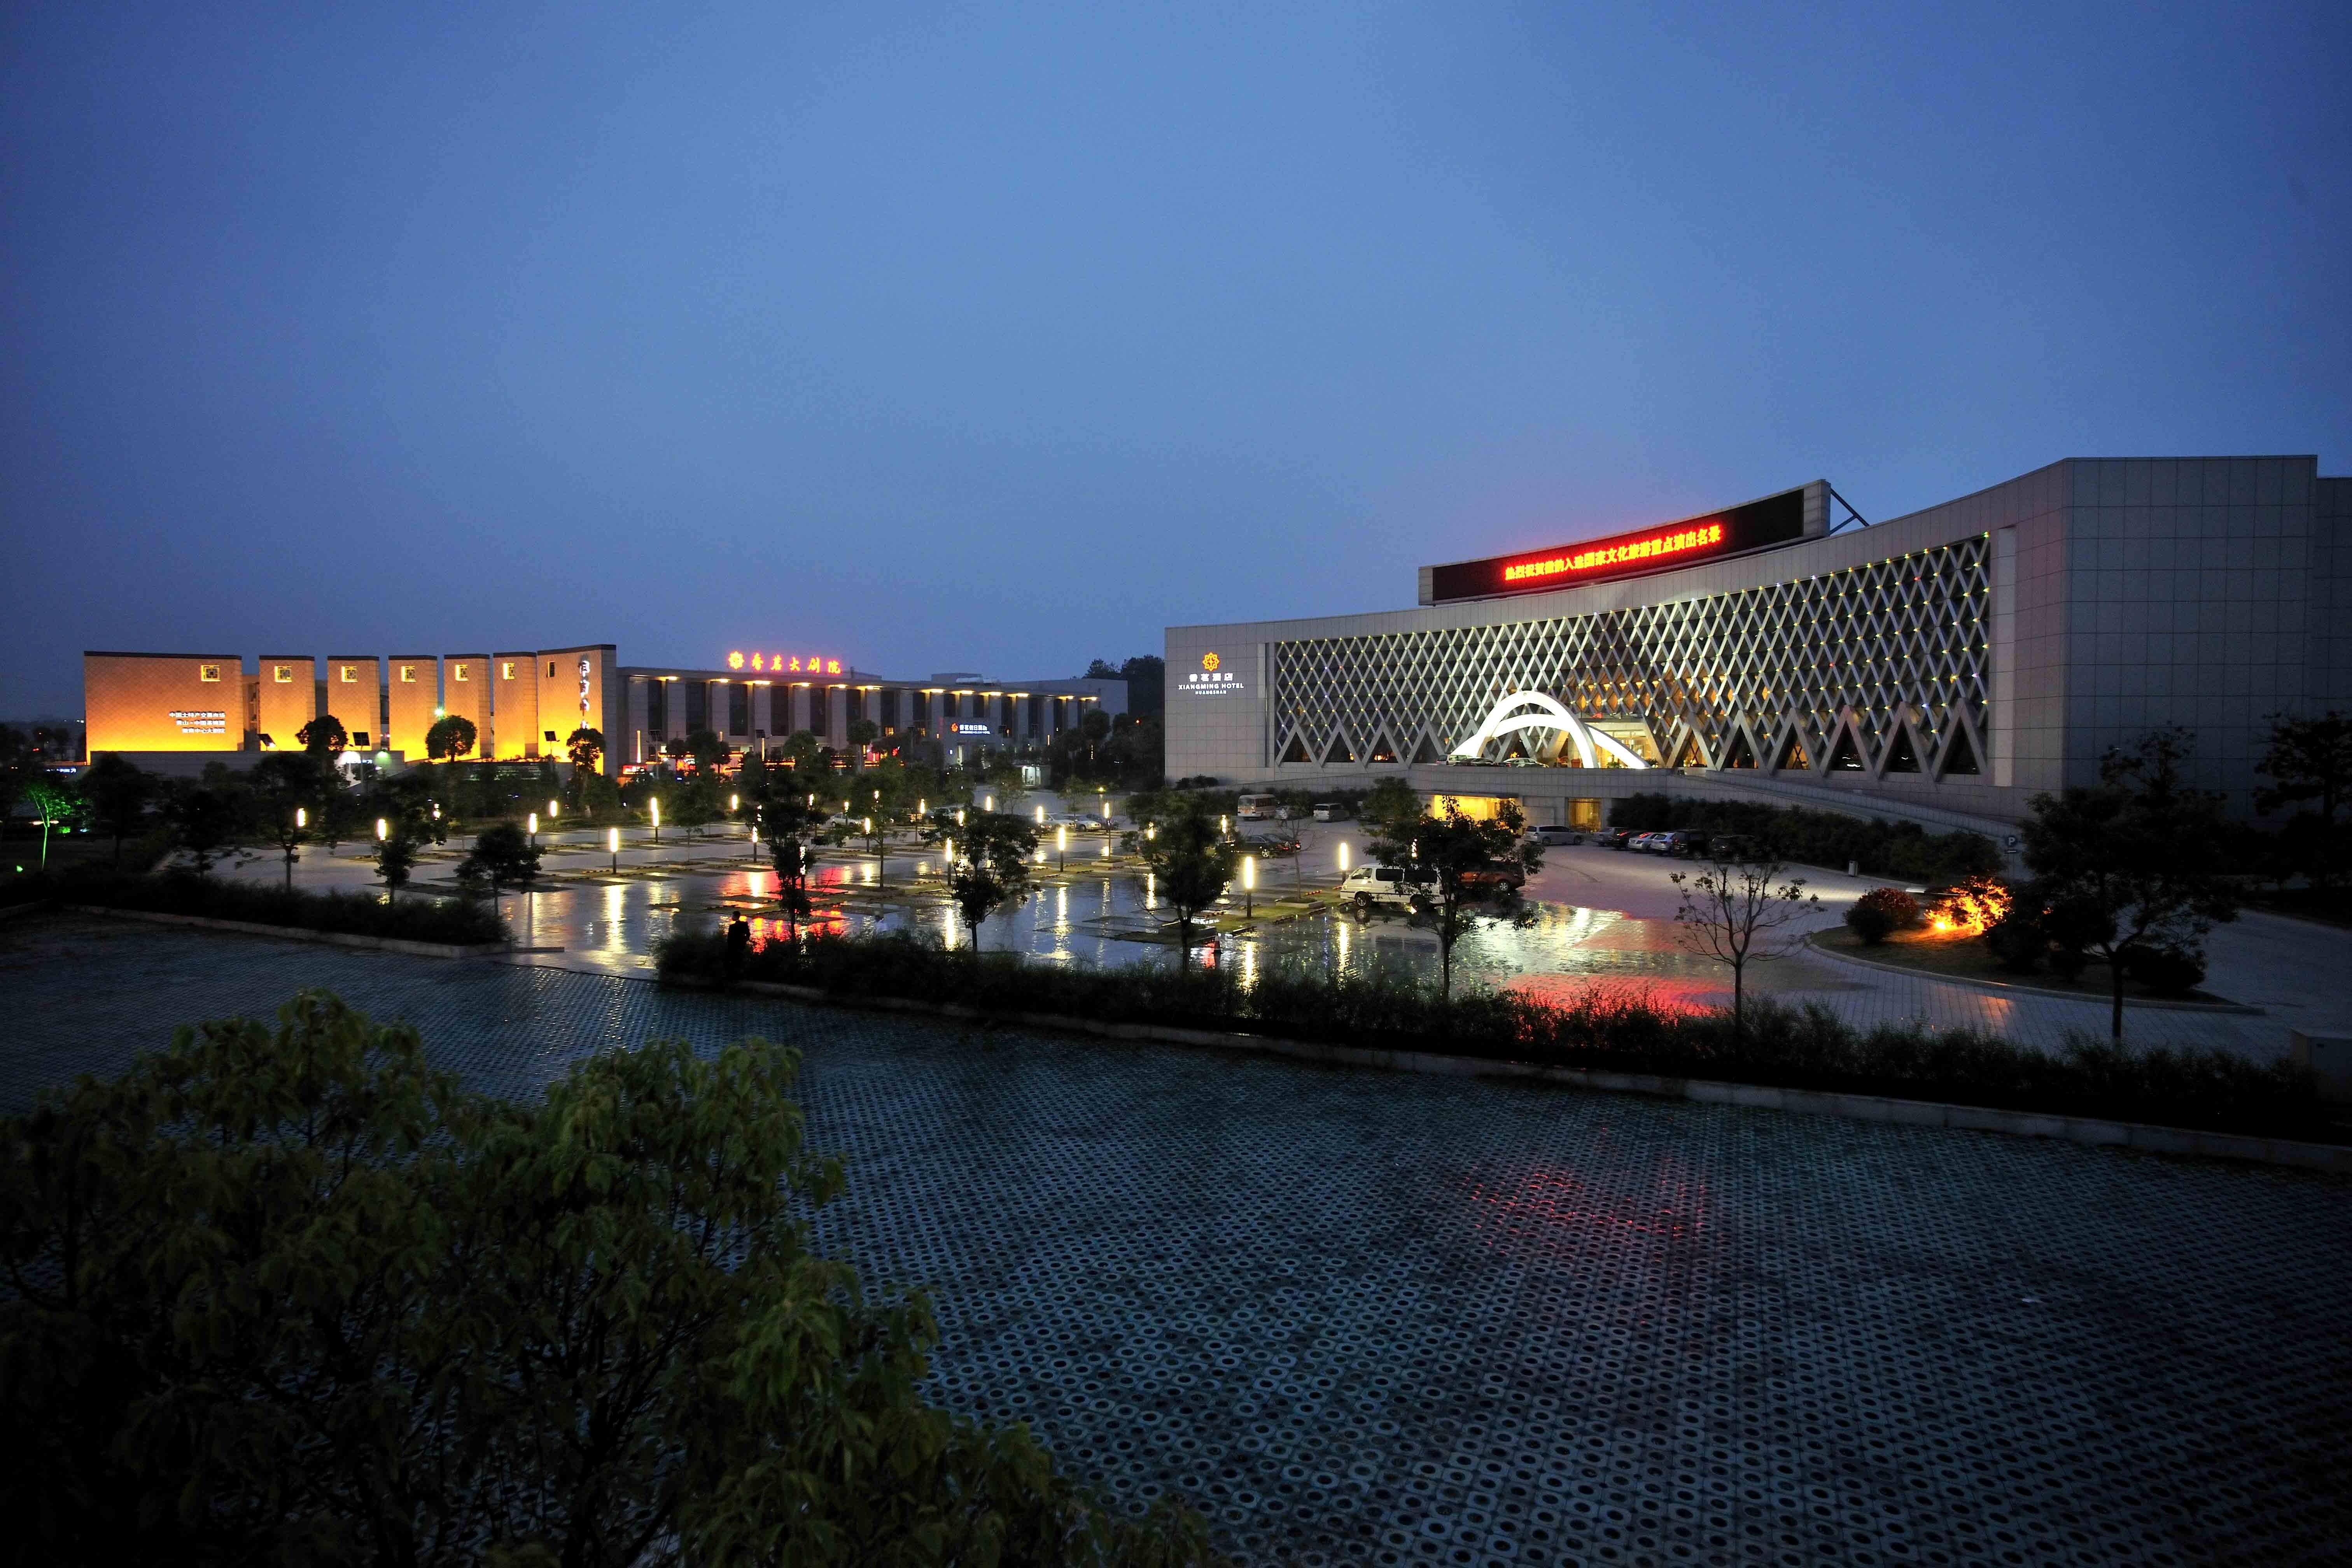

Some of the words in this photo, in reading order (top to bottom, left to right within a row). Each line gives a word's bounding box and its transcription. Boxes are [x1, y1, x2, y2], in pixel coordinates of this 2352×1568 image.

[751, 653, 841, 674] 香茗大剧院
[1189, 673, 1233, 682] 香茗酒店
[2008, 837, 2016, 845] P
